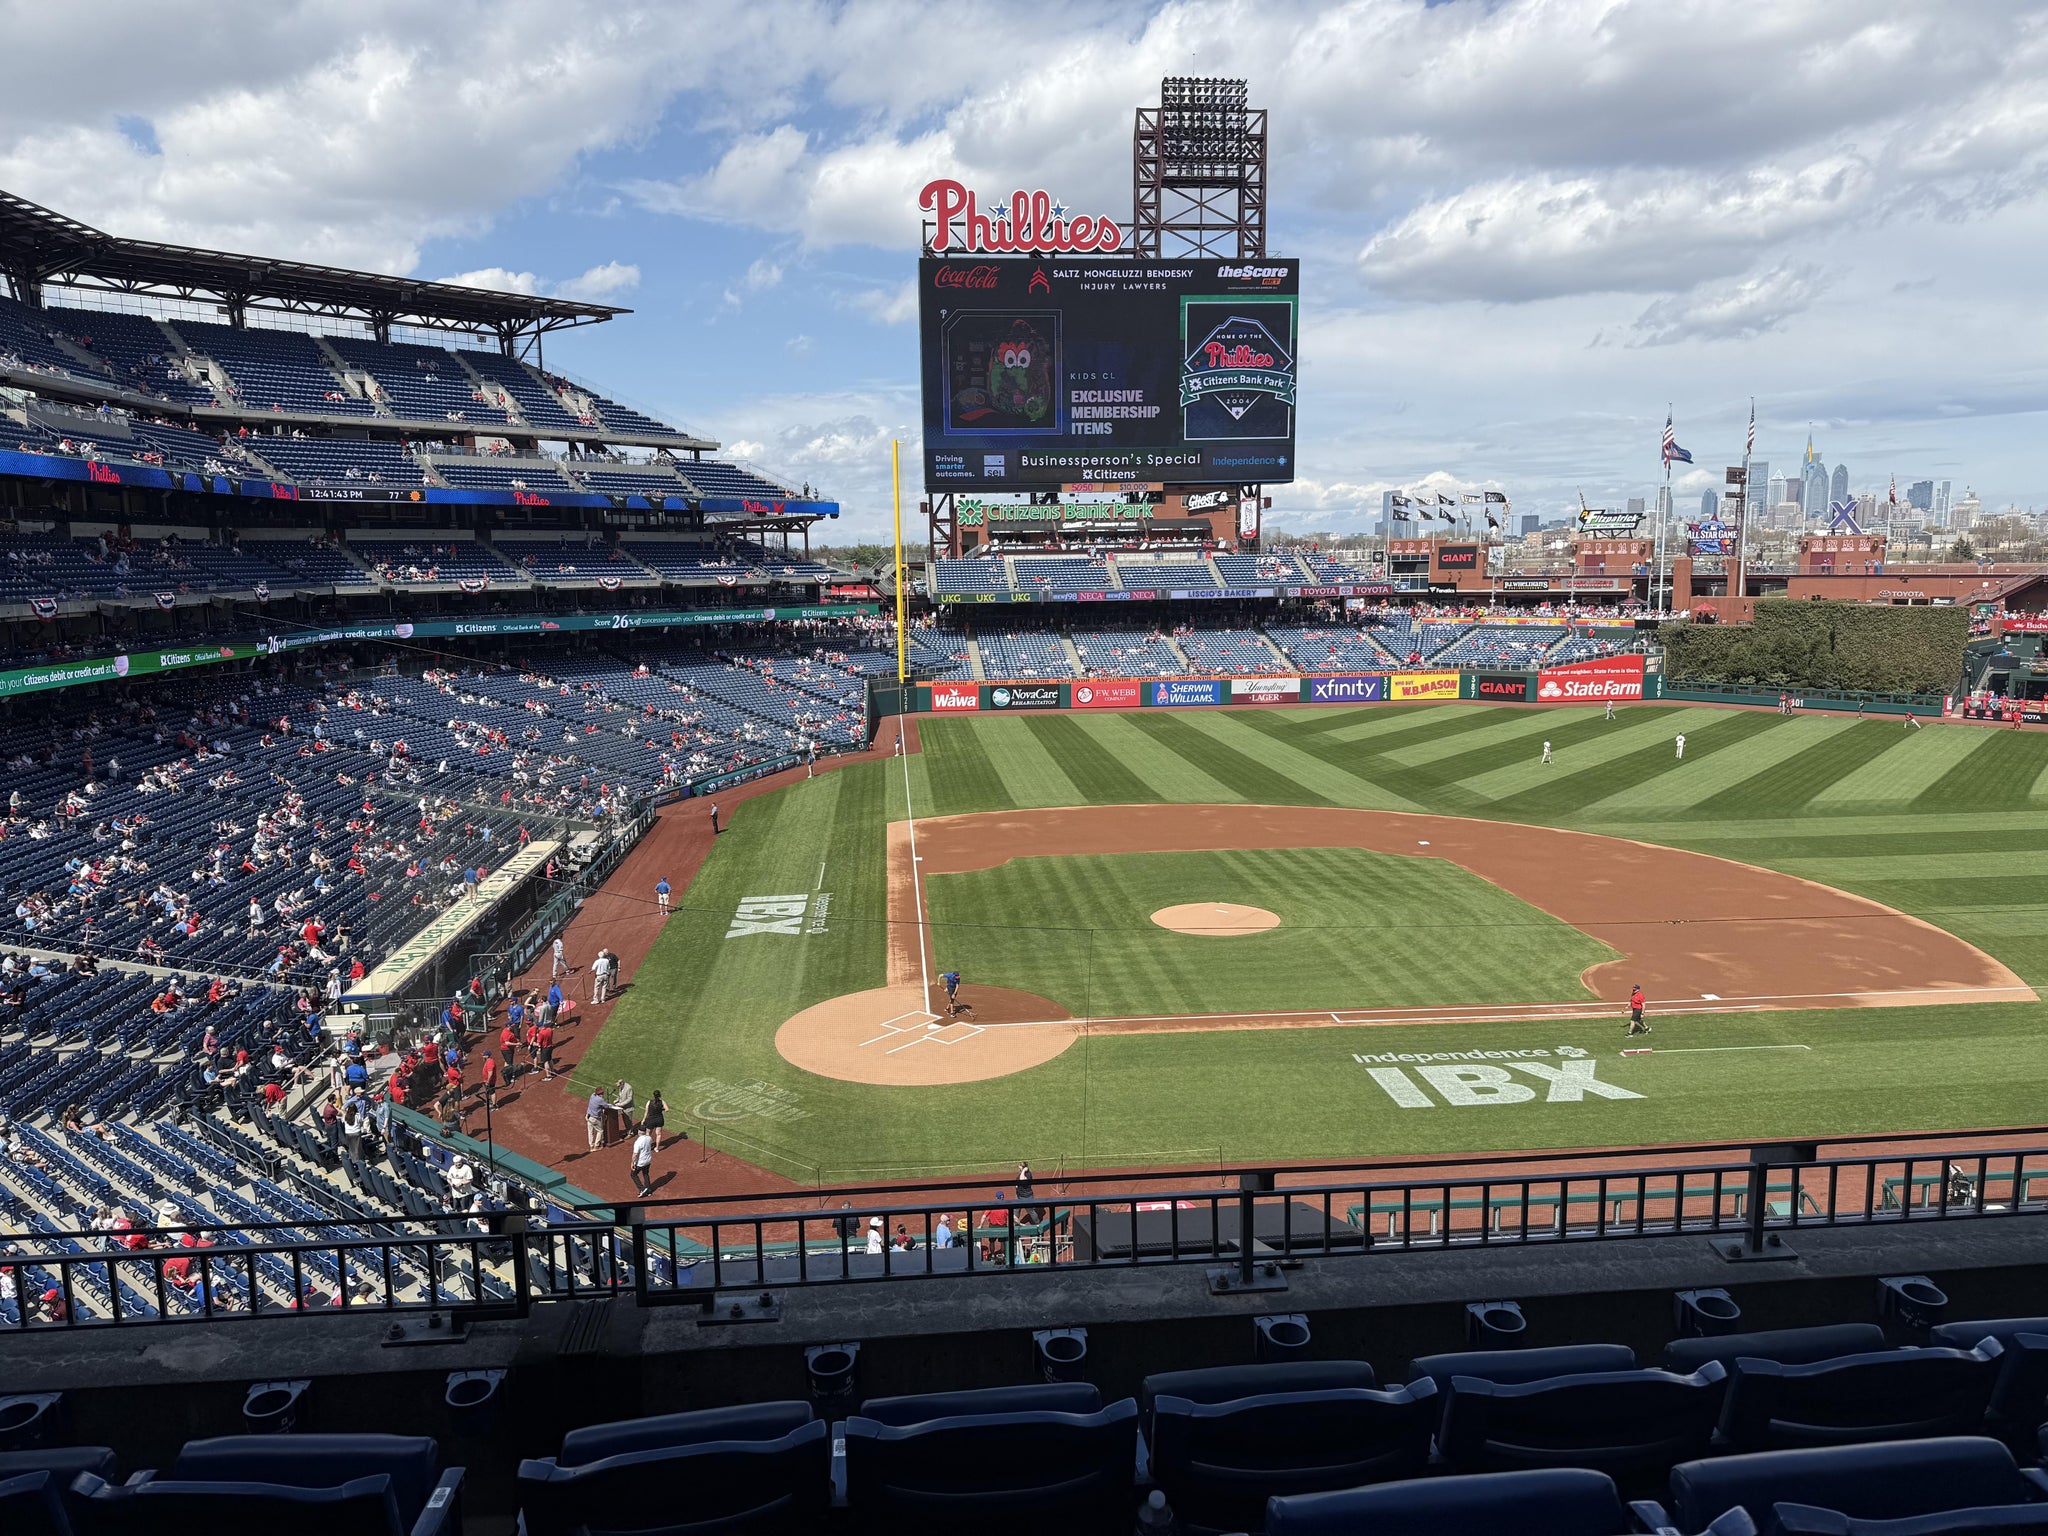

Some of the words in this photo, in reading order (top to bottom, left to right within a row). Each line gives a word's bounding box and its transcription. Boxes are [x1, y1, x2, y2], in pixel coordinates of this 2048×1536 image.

[919, 179, 1122, 253] Phillies
[934, 265, 1000, 289] Coca-Cola
[1053, 269, 1080, 278] SALTZ
[1084, 269, 1143, 278] MONGELUZZI
[1147, 269, 1193, 278] BENDESKY
[1217, 265, 1288, 278] theScore
[1080, 282, 1116, 291] INJURY
[1123, 282, 1167, 291] LAWYERS
[1205, 342, 1275, 368] Phillies
[1203, 376, 1238, 387] Citizens
[1240, 374, 1262, 385] Bank
[1264, 377, 1284, 388] Park
[1070, 390, 1143, 403] EXCLUSIVE
[1070, 406, 1160, 419] MEMBERSHIP
[1071, 422, 1113, 435] ITEMS
[935, 455, 963, 463] Driving
[1022, 453, 1141, 468] Businessperson's
[1147, 453, 1201, 467] Special
[1212, 456, 1275, 467] Independence
[88, 461, 121, 484] Phillies
[1094, 469, 1136, 480] Citizens
[310, 489, 348, 499] 12:41:43
[350, 490, 363, 499] PM
[513, 491, 550, 506] Phillies
[987, 503, 1061, 521] Citizens
[1064, 501, 1110, 520] Bank
[1114, 500, 1154, 519] Park
[1585, 511, 1638, 524] Fitzpatrick
[1686, 530, 1700, 539] ALL
[1700, 530, 1718, 539] STAR
[1719, 529, 1738, 539] GAME
[1441, 554, 1474, 562] GIANT
[1080, 591, 1103, 600] NECA
[1133, 590, 1156, 599] NECA
[1187, 589, 1222, 598] LISCIO'S
[1224, 588, 1257, 597] BAKERY
[1303, 587, 1337, 596] TOYOTA
[1356, 585, 1389, 595] TOYOTA
[941, 593, 960, 603] UKG
[976, 593, 996, 602] UKG
[1011, 592, 1031, 602] UKG
[807, 609, 828, 617] Citizens
[594, 619, 611, 627] Score
[642, 616, 671, 624] concessions
[694, 614, 713, 622] Citizens
[713, 613, 725, 621] debit
[732, 612, 745, 620] credit
[345, 629, 366, 639] credit
[367, 628, 382, 638] card
[465, 624, 496, 633] Citizens
[167, 653, 190, 665] Citizens
[8, 678, 23, 691] your
[24, 671, 49, 686] Citizens
[50, 668, 67, 682] debit
[67, 669, 74, 679] or
[75, 664, 91, 678] credit
[92, 663, 104, 675] card
[1570, 668, 1592, 676] neighbor,
[1111, 688, 1136, 697] WEBB
[1170, 683, 1213, 693] SHERWIN
[1315, 679, 1376, 699] xfinity
[1480, 683, 1526, 695] GIANT
[1011, 688, 1058, 700] NovaCare
[1252, 693, 1280, 702] LAGER
[934, 694, 977, 708] Wawa
[1792, 699, 1804, 707] 01
[725, 893, 808, 939] IBX
[1352, 1046, 1551, 1064] Independence
[1365, 1059, 1648, 1108] IBX
